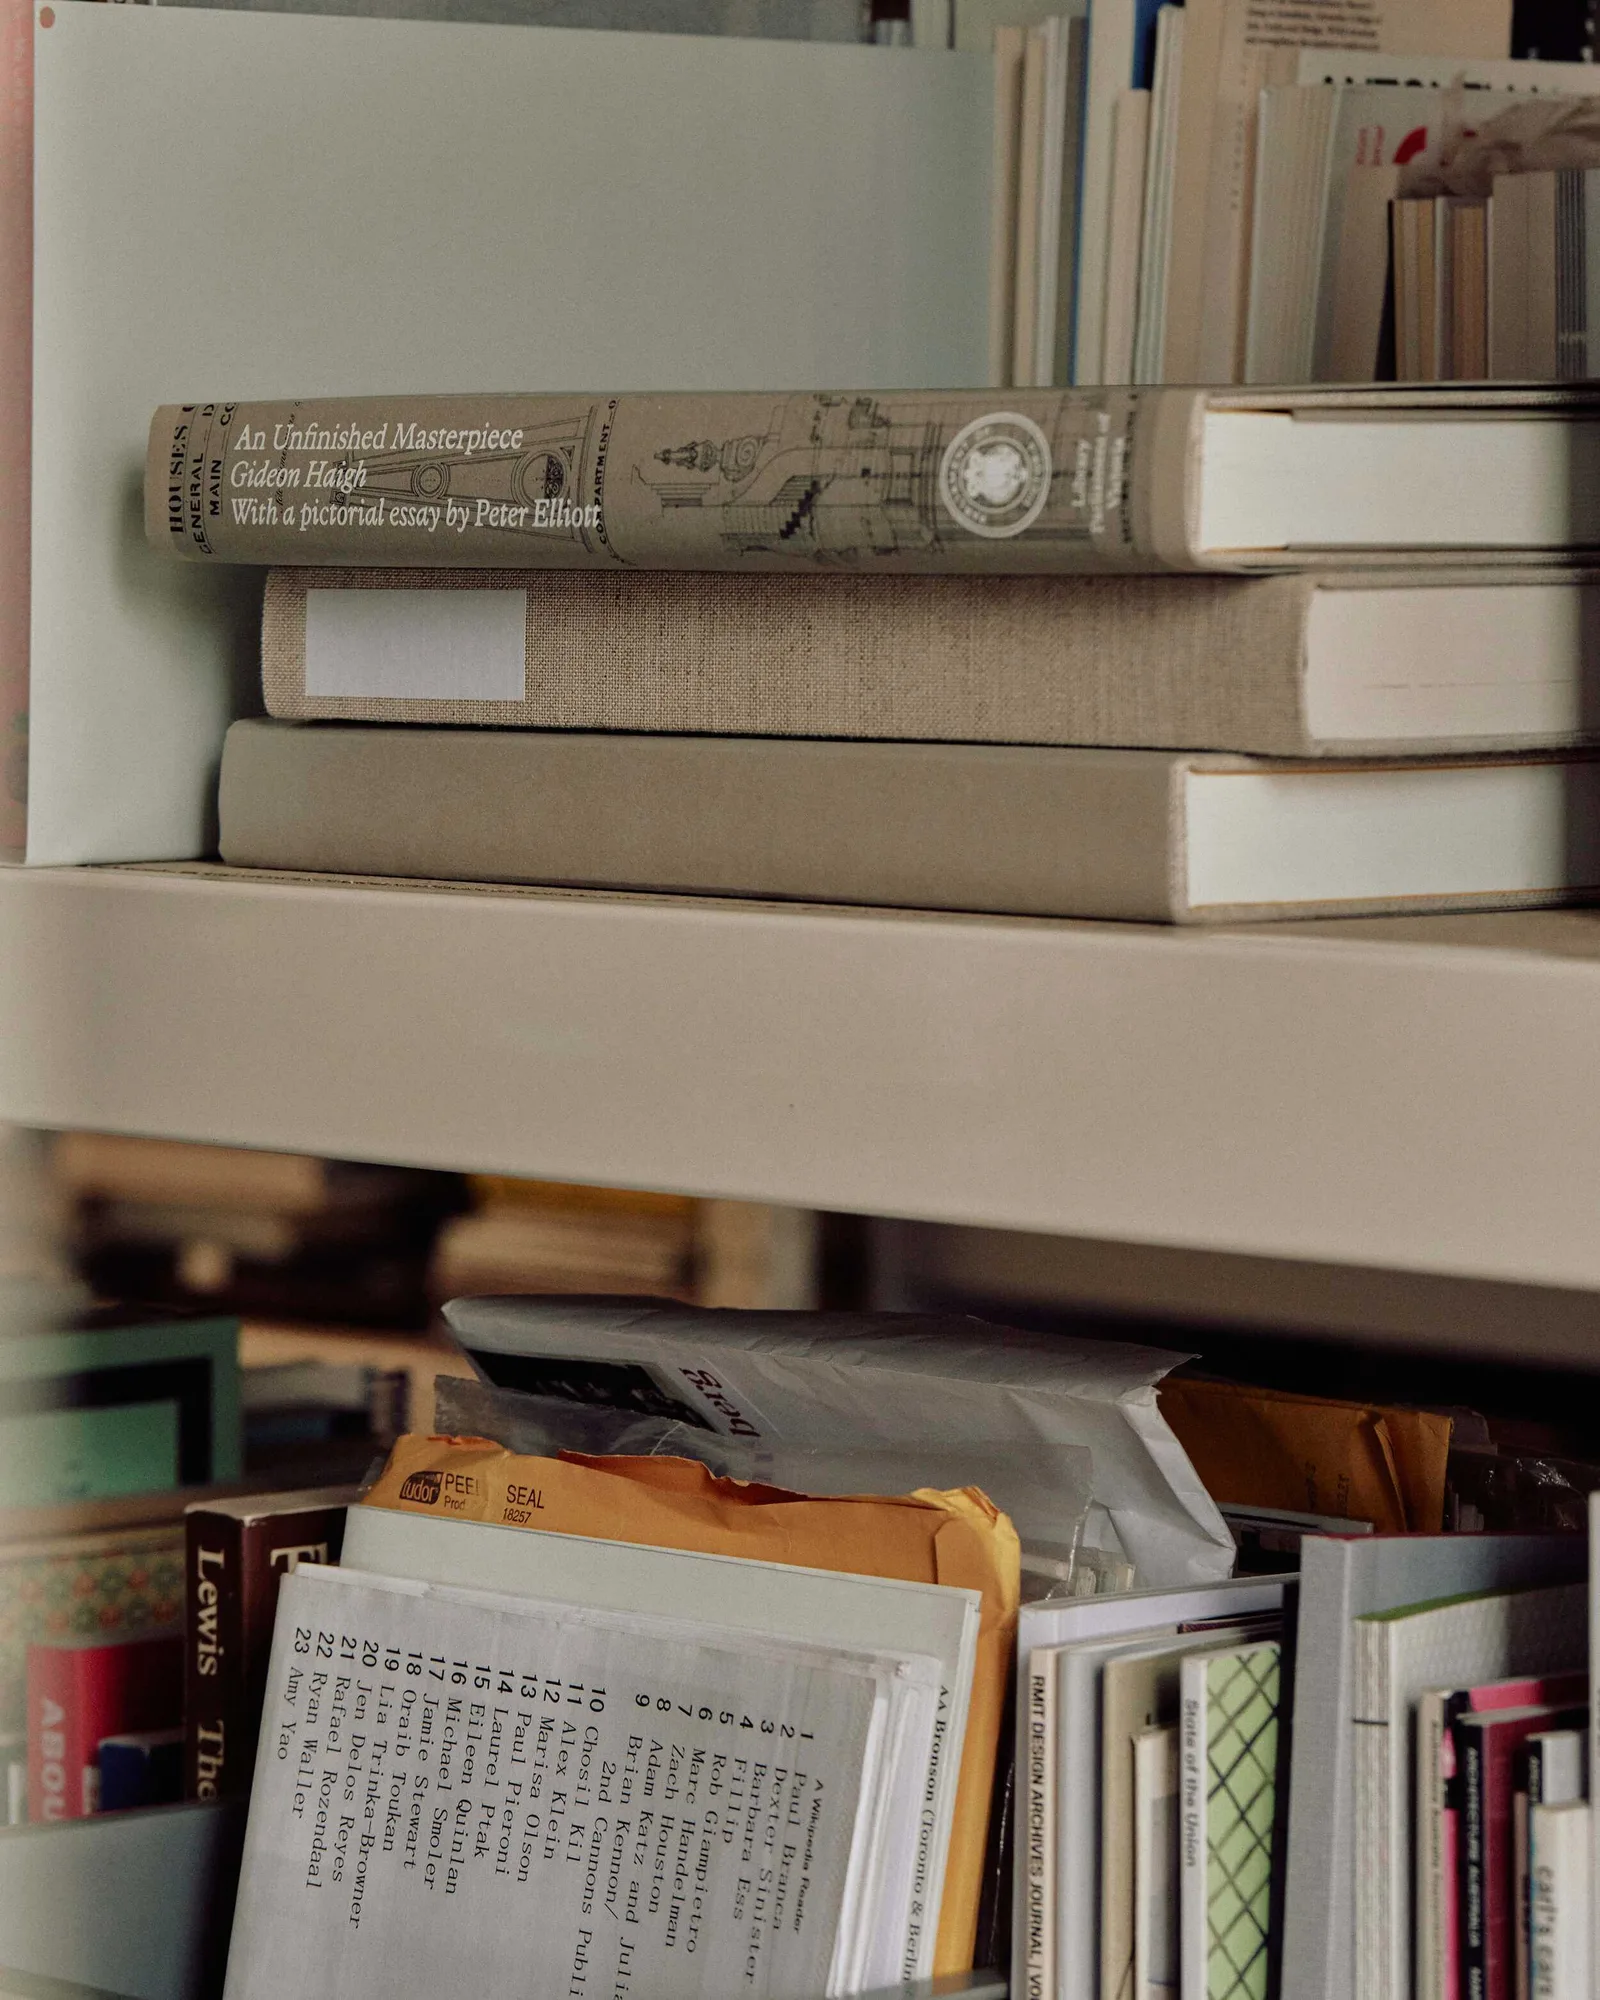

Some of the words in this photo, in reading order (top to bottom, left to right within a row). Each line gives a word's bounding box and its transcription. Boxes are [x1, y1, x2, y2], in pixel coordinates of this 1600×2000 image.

[234, 422, 265, 451] An
[273, 422, 387, 451] Unfinished
[390, 423, 523, 457] Masterpiece
[168, 425, 189, 534] HOUSES
[209, 459, 222, 516] MAIN
[230, 461, 300, 489] Gideon
[305, 461, 366, 494] Haigh
[230, 498, 278, 526] With
[282, 505, 296, 525] a
[299, 498, 385, 531] pictorial
[389, 504, 441, 531] essay
[446, 499, 470, 531] by
[473, 500, 528, 527] Peter
[532, 499, 601, 528] Elliott
[502, 1507, 532, 1524] 18257
[506, 1484, 545, 1509] SEAL
[197, 1545, 225, 1676] Lewis
[293, 1626, 312, 1654] 23
[315, 1630, 335, 1659] 22
[339, 1634, 357, 1660] 21
[361, 1639, 379, 1668] 20
[383, 1647, 401, 1671] 19
[405, 1651, 423, 1676] 18
[427, 1655, 446, 1681] 17
[283, 1665, 304, 1707] Amy
[305, 1670, 328, 1724] Ryan
[353, 1678, 373, 1720] Jen
[450, 1660, 468, 1685] 16
[473, 1664, 491, 1690] 15
[496, 1669, 515, 1694] 14
[519, 1673, 538, 1699] 13
[542, 1678, 562, 1703] 12
[566, 1682, 585, 1705] 11
[588, 1687, 606, 1713] 10
[634, 1693, 650, 1707] 9
[936, 1684, 950, 1713] AA
[1031, 1675, 1046, 1717] RMIT
[325, 1675, 351, 1754] Rafael
[375, 1684, 395, 1724] Lia
[394, 1688, 417, 1757] Oraib
[417, 1691, 440, 1762] Jamie
[655, 1696, 671, 1712] 8
[676, 1703, 693, 1717] 7
[697, 1706, 713, 1721] 6
[718, 1710, 734, 1725] 5
[738, 1714, 754, 1729] 4
[759, 1718, 775, 1734] 3
[779, 1723, 795, 1739] 2
[1185, 1698, 1199, 1751] State
[197, 1719, 225, 1801] The
[276, 1721, 297, 1760] Yao
[436, 1696, 463, 1791] Michael
[460, 1701, 486, 1784] Eileen
[483, 1706, 509, 1787] Laurel
[509, 1710, 532, 1764] Paul
[528, 1715, 555, 1799] Marisa
[554, 1719, 577, 1776] Alex
[799, 1732, 814, 1740] 1
[925, 1718, 948, 1801] Bronson
[1031, 1721, 1046, 1785] DESIGN
[291, 1739, 318, 1819] Waller
[342, 1732, 366, 1801] Delos
[573, 1725, 599, 1806] Chosil
[597, 1760, 617, 1803] 2nd
[619, 1734, 643, 1804] Brian
[642, 1738, 664, 1797] Adam
[663, 1743, 685, 1800] Zach
[685, 1747, 706, 1804] Marc
[708, 1752, 727, 1796] Rob
[813, 1778, 824, 1791] A
[1185, 1753, 1199, 1776] of
[381, 1771, 407, 1851] Toukan
[721, 1757, 747, 1844] Fillip
[740, 1761, 767, 1862] Barbara
[763, 1766, 788, 1854] Dexter
[786, 1770, 807, 1826] Paul
[1186, 1778, 1199, 1808] the
[305, 1769, 338, 1888] Rozendaal
[331, 1814, 355, 1882] Reyes
[348, 1739, 388, 1929] Trinka-Browner
[402, 1774, 429, 1869] Stewart
[423, 1806, 448, 1890] Smoler
[444, 1798, 472, 1894] Quinlan
[473, 1801, 496, 1858] Ptak
[494, 1779, 522, 1875] Pieroni
[516, 1812, 540, 1882] Olson
[542, 1789, 567, 1859] Klein
[565, 1822, 585, 1862] Kil
[632, 1809, 654, 1865] Katz
[801, 1797, 822, 1871] Wikipedia
[1030, 1788, 1045, 1877] ARCHIVES
[1186, 1813, 1199, 1868] Union
[581, 1816, 608, 1915] Cannons
[603, 1818, 631, 1920] Kennon/
[647, 1813, 675, 1913] Houston
[914, 1808, 936, 1894] (Toronto
[624, 1879, 639, 1924] and
[664, 1818, 696, 1947] Handelman
[686, 1809, 718, 1953] Giampietro
[732, 1876, 751, 1920] Ess
[771, 1843, 796, 1930] Branca
[792, 1876, 810, 1934] Reader
[910, 1900, 924, 1916] &
[744, 1867, 773, 1984] Sinister
[1030, 1882, 1044, 1959] JOURNAL
[567, 1927, 593, 1997] Publi
[903, 1923, 921, 1981] Berlin
[1029, 1974, 1043, 2000] VO
